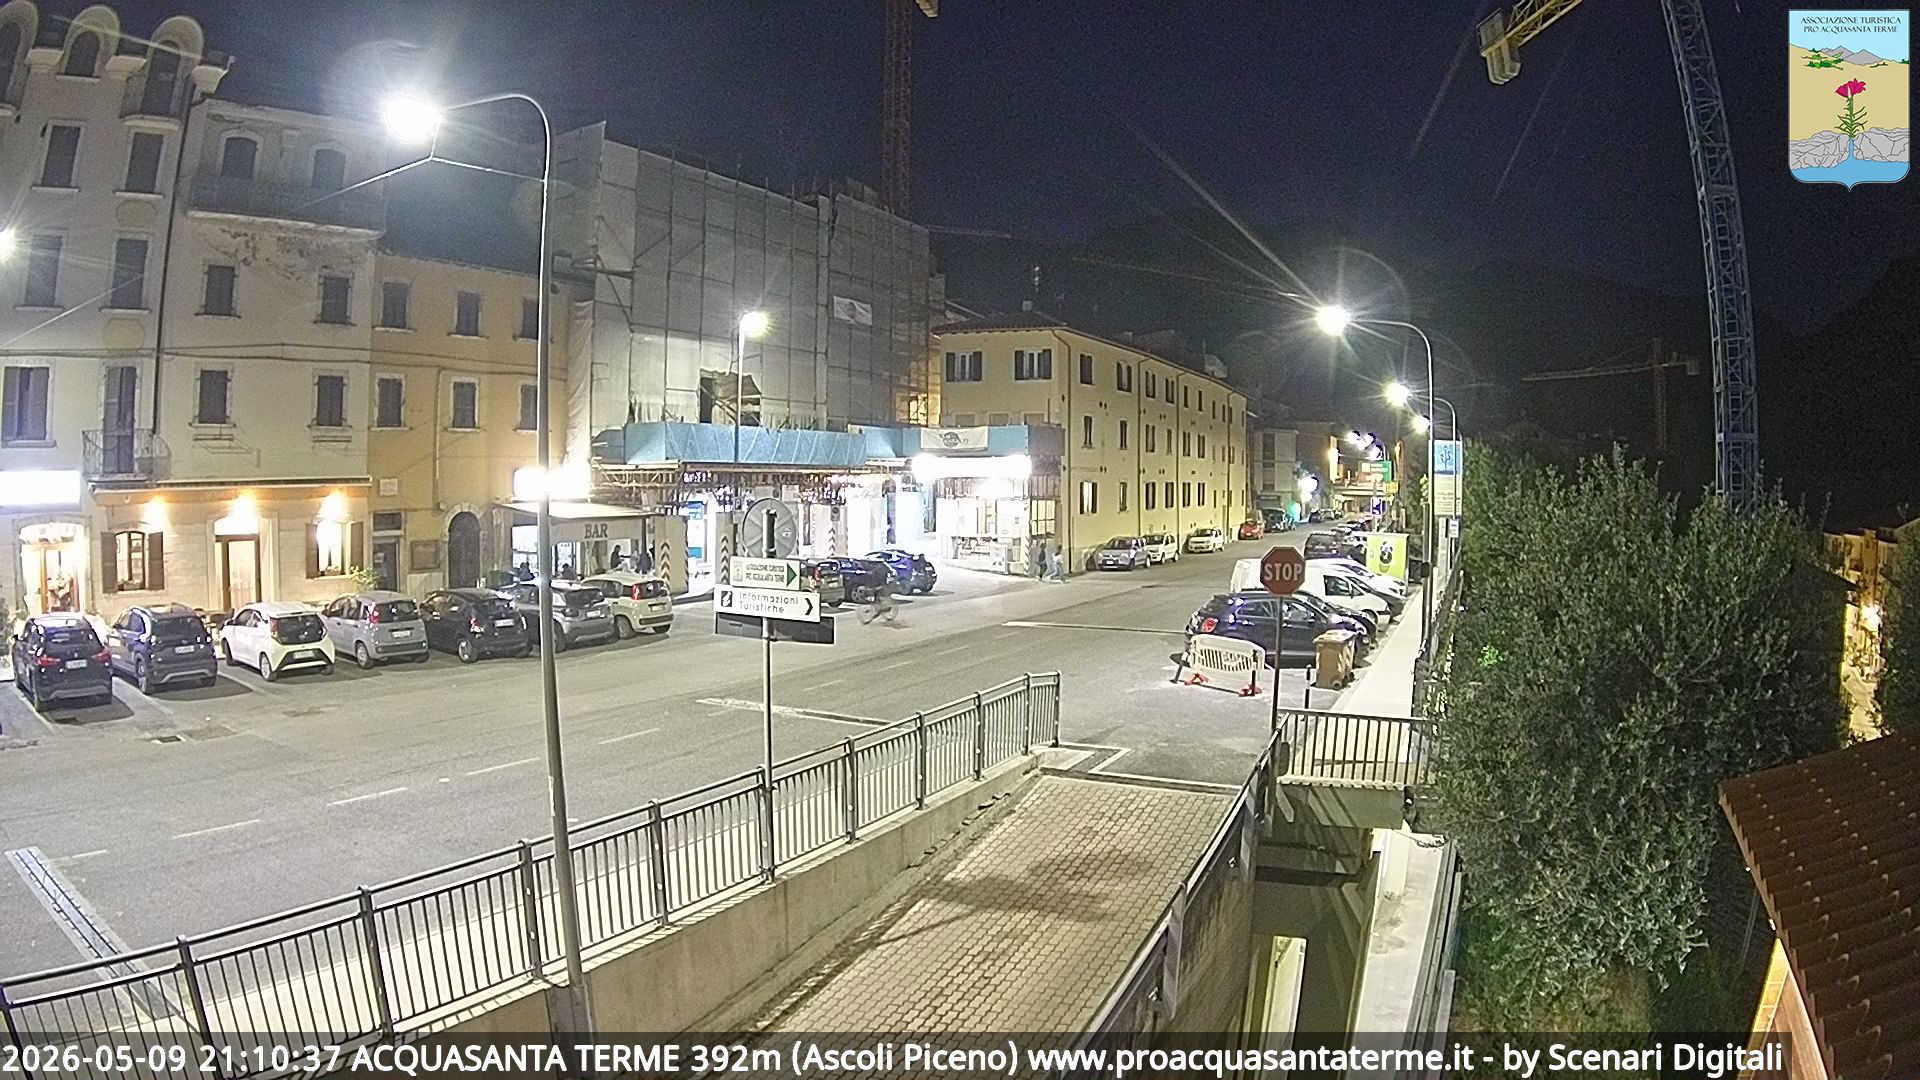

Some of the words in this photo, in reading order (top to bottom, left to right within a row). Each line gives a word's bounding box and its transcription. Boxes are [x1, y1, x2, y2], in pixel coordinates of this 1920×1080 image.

[584, 523, 608, 539] BAR
[1264, 563, 1303, 581] STOP
[740, 600, 784, 613] Turistiche
